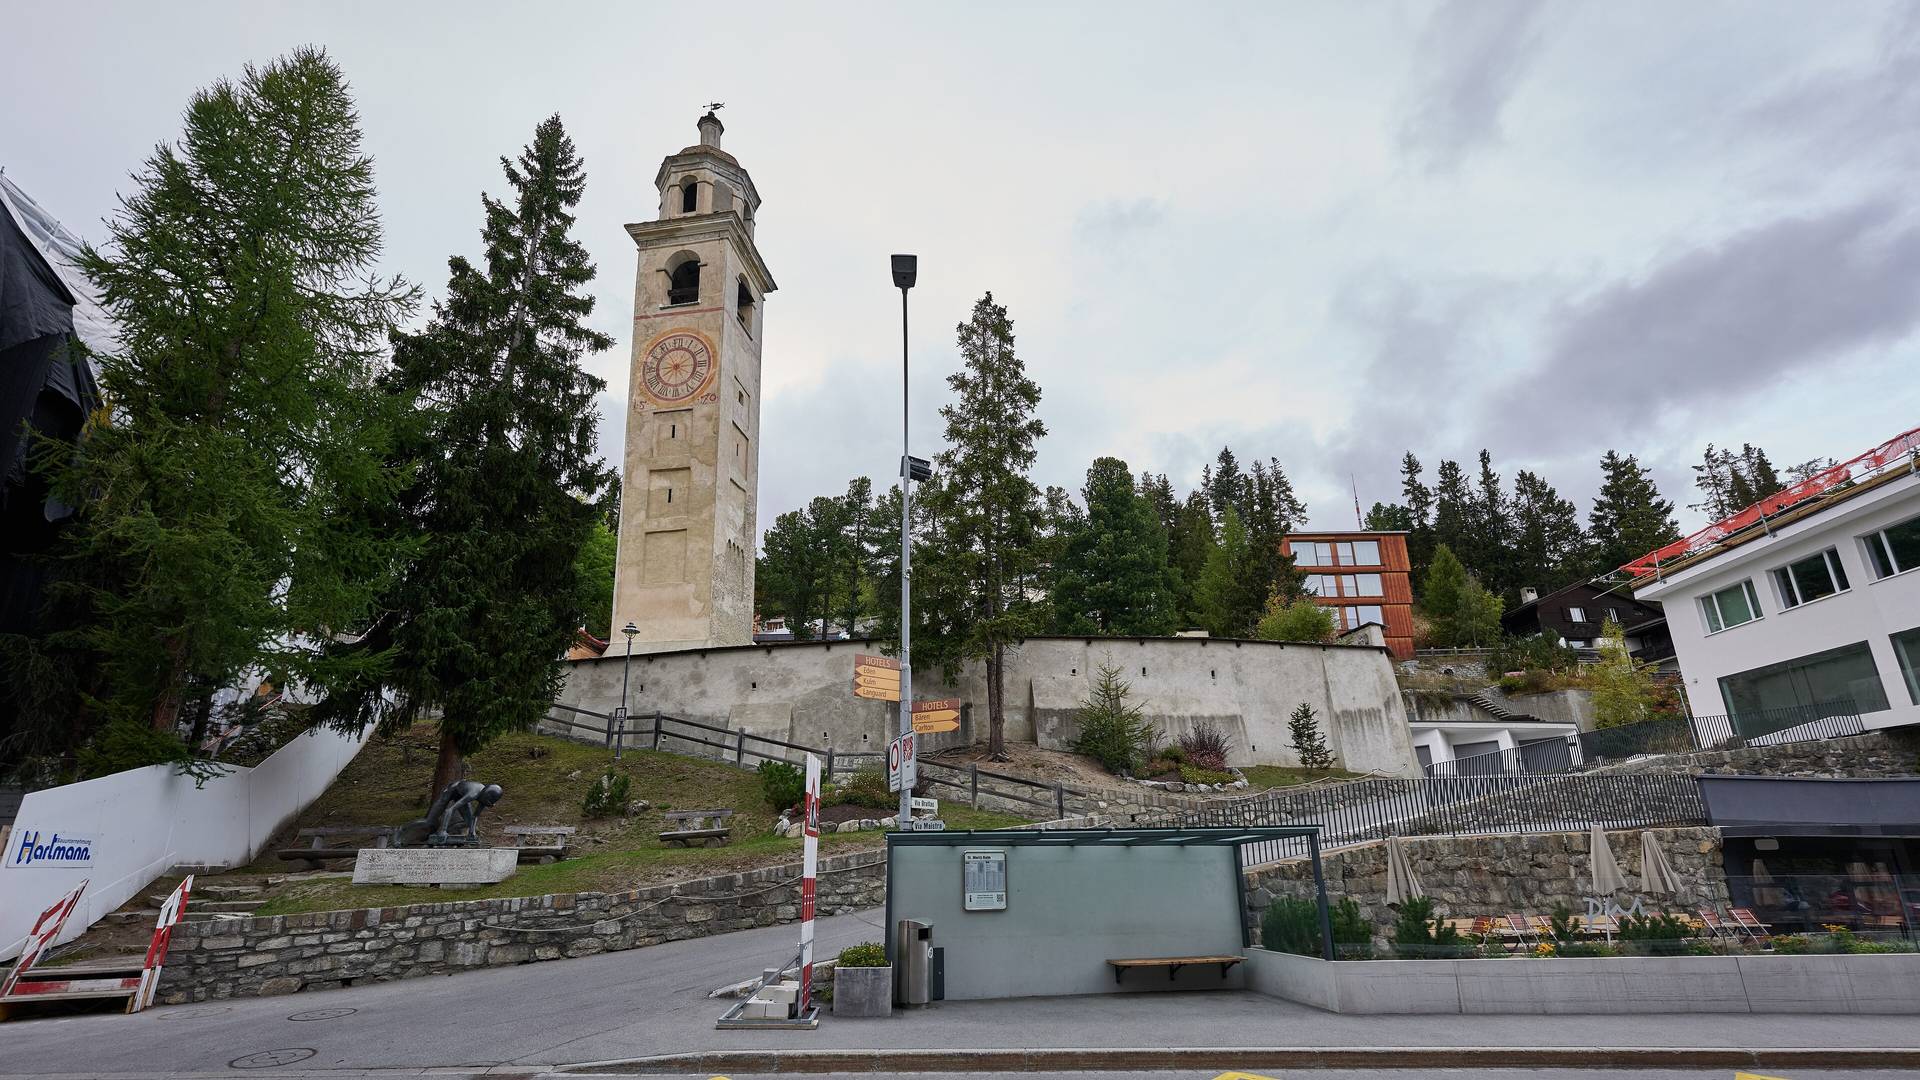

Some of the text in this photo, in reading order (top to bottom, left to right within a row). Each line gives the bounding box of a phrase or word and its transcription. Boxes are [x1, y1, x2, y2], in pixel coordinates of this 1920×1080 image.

[865, 656, 890, 668] HOTELS
[863, 689, 887, 698] Languard
[922, 700, 949, 711] HOTELS
[914, 822, 943, 830] Via Maistra
